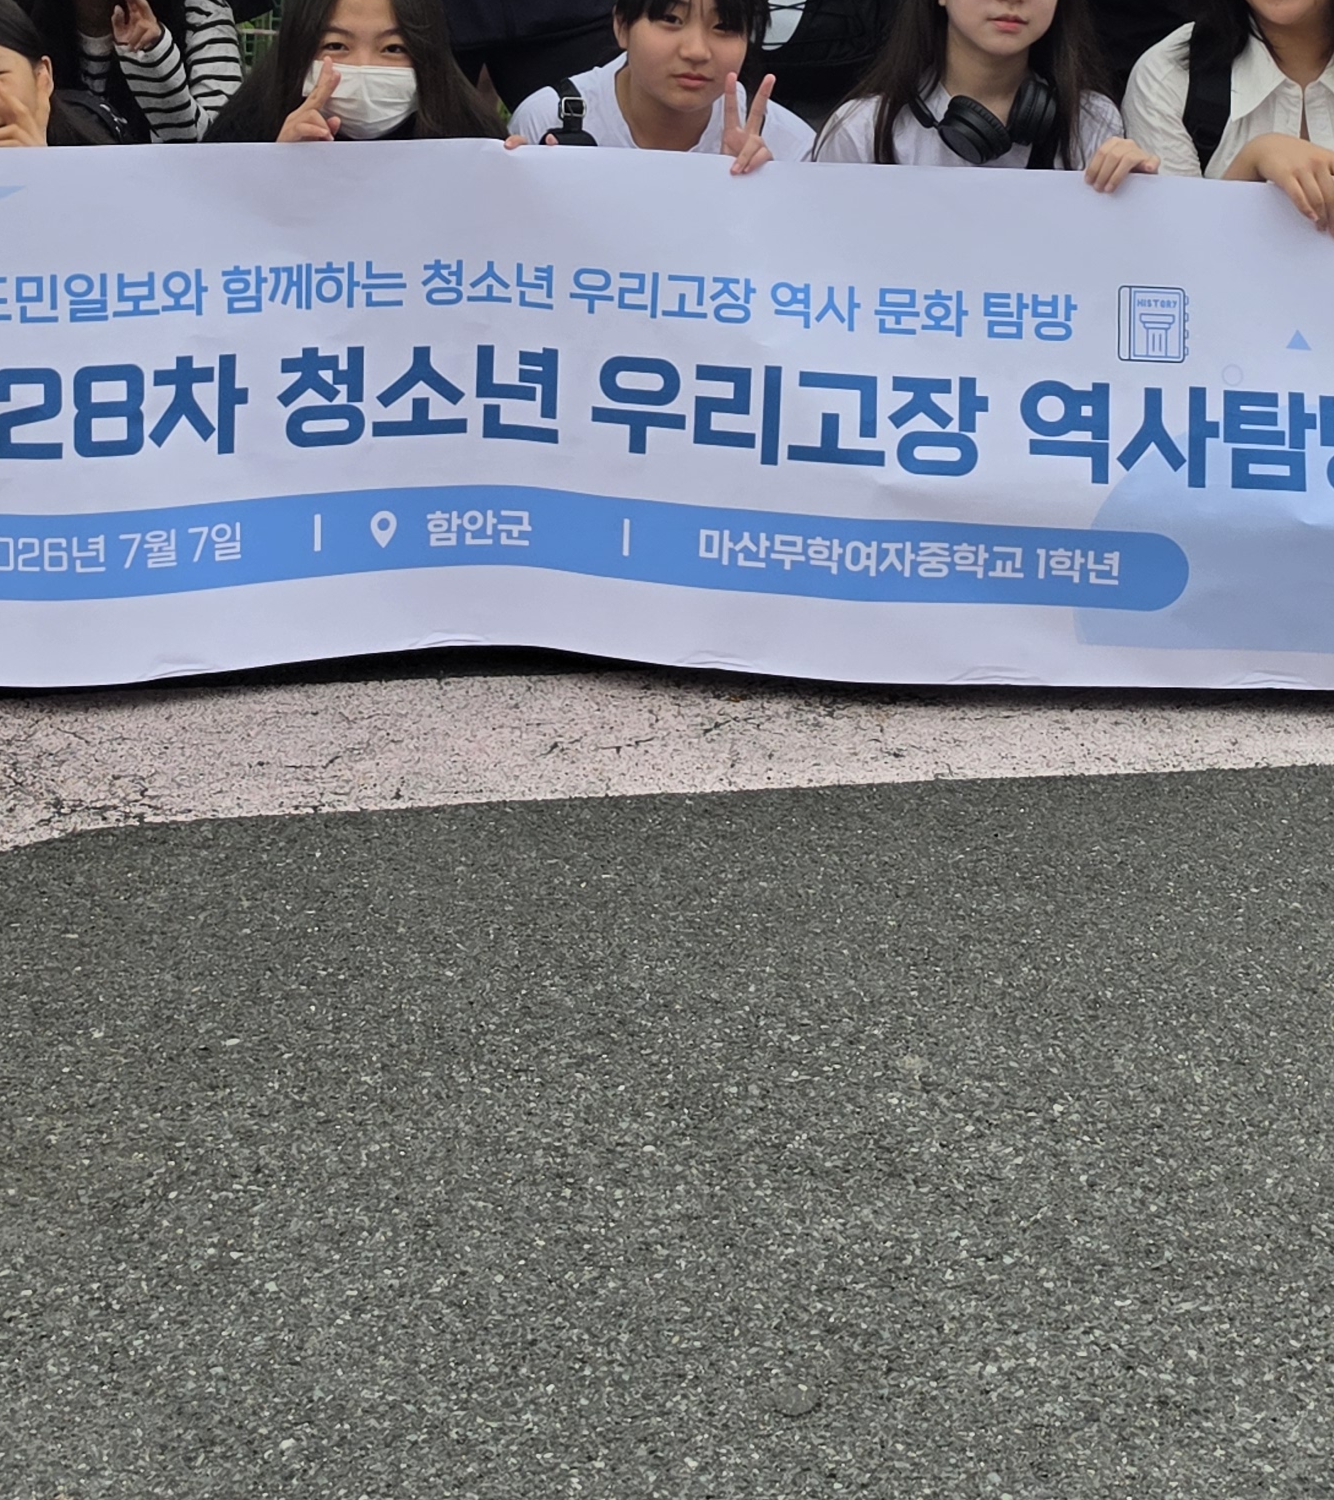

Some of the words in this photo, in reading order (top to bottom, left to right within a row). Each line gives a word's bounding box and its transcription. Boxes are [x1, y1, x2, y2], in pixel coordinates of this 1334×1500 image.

[221, 260, 407, 314] 함께하는
[421, 259, 554, 311] 청소년
[569, 267, 756, 324] 우리고장
[770, 281, 861, 332] 역사
[874, 288, 969, 337] 문화
[983, 292, 1078, 341] 탐방
[276, 344, 559, 448] 청소년
[591, 355, 989, 477] 우리고장
[118, 528, 178, 569] 7월
[187, 522, 242, 562] 7일
[426, 510, 533, 547] 함안군
[698, 528, 1024, 579] 마산무학여자중학교
[1037, 547, 1121, 586] 1학년
